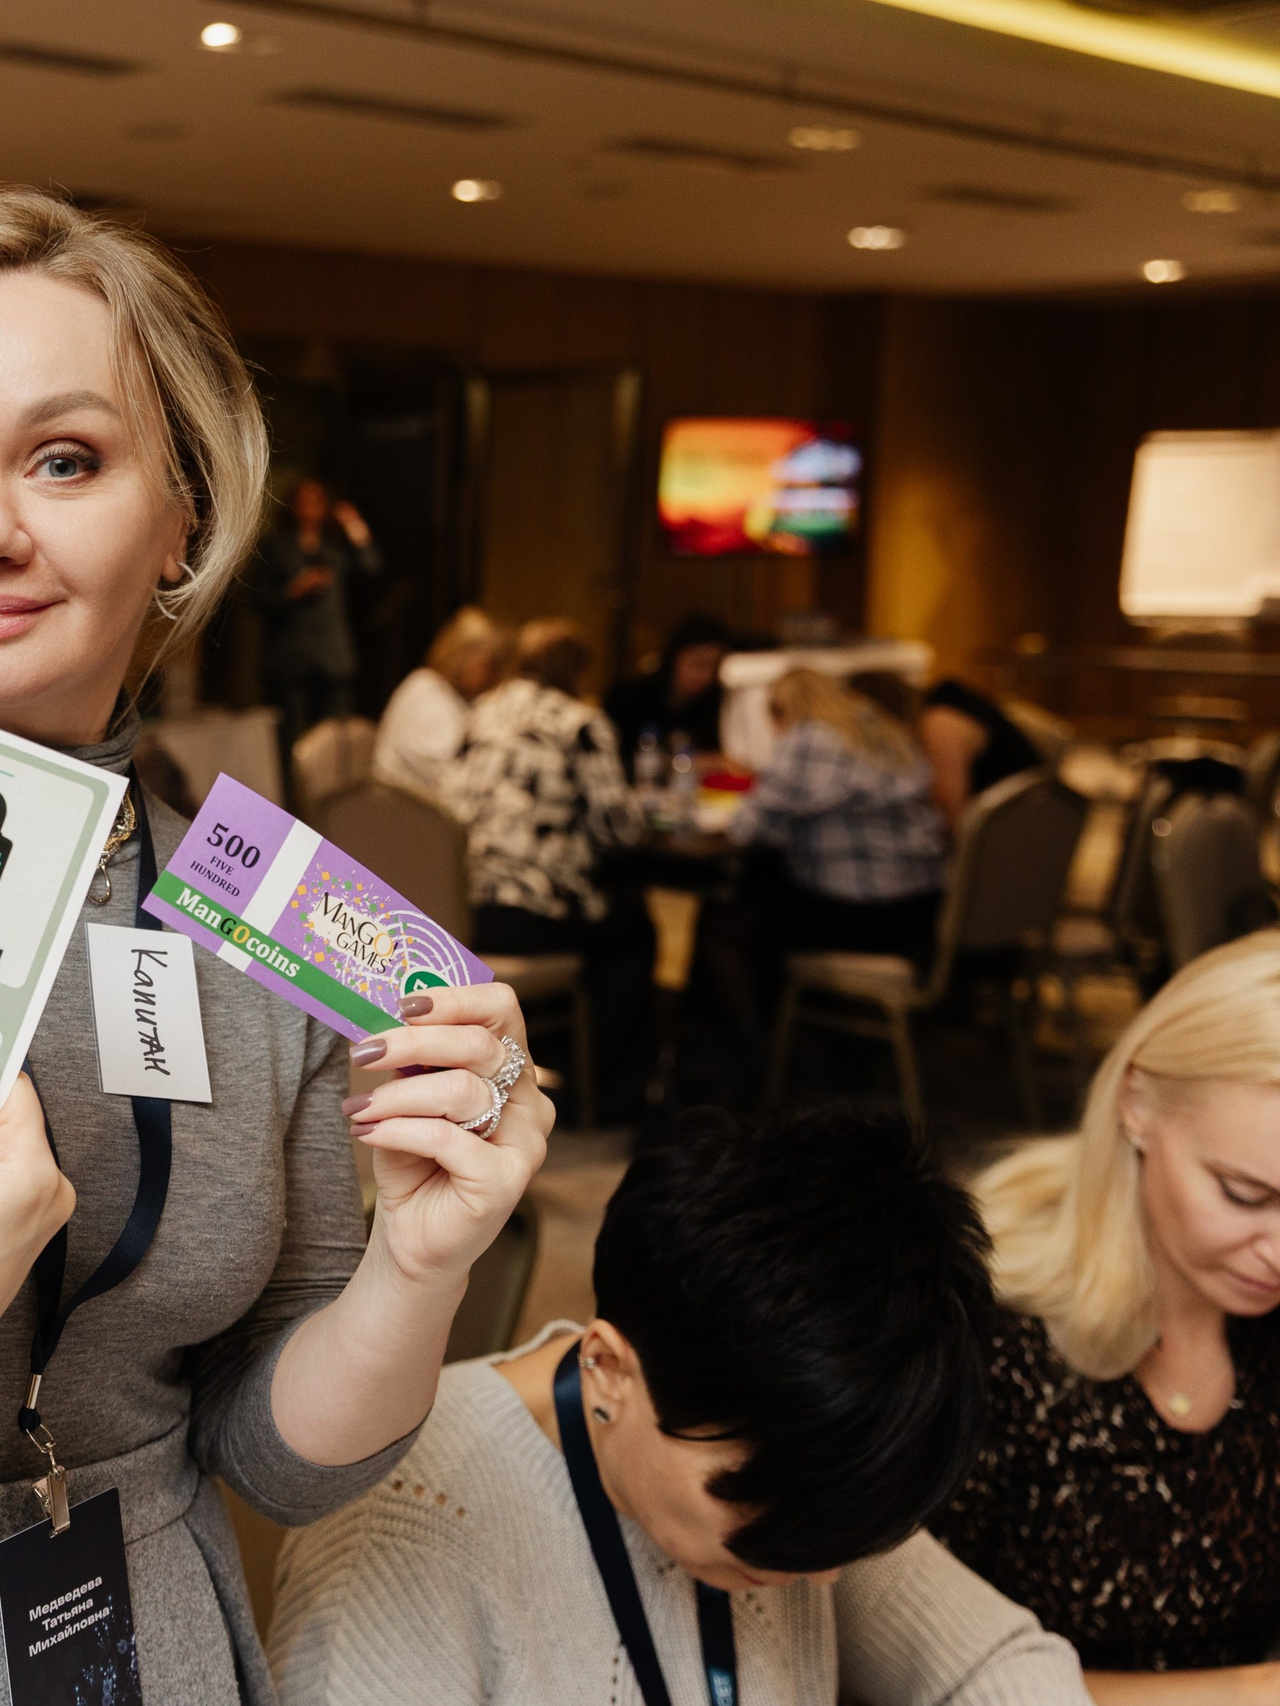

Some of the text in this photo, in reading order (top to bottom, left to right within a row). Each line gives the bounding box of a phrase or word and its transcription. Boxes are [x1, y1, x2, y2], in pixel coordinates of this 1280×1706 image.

[206, 822, 261, 868] 500
[210, 856, 235, 876] FIVE
[190, 860, 241, 897] HUNDRED
[175, 887, 301, 978] ManGOcoins
[28, 1575, 103, 1622] Медведева
[41, 1597, 94, 1632] Татьяна
[28, 1605, 111, 1658] Михайловна
